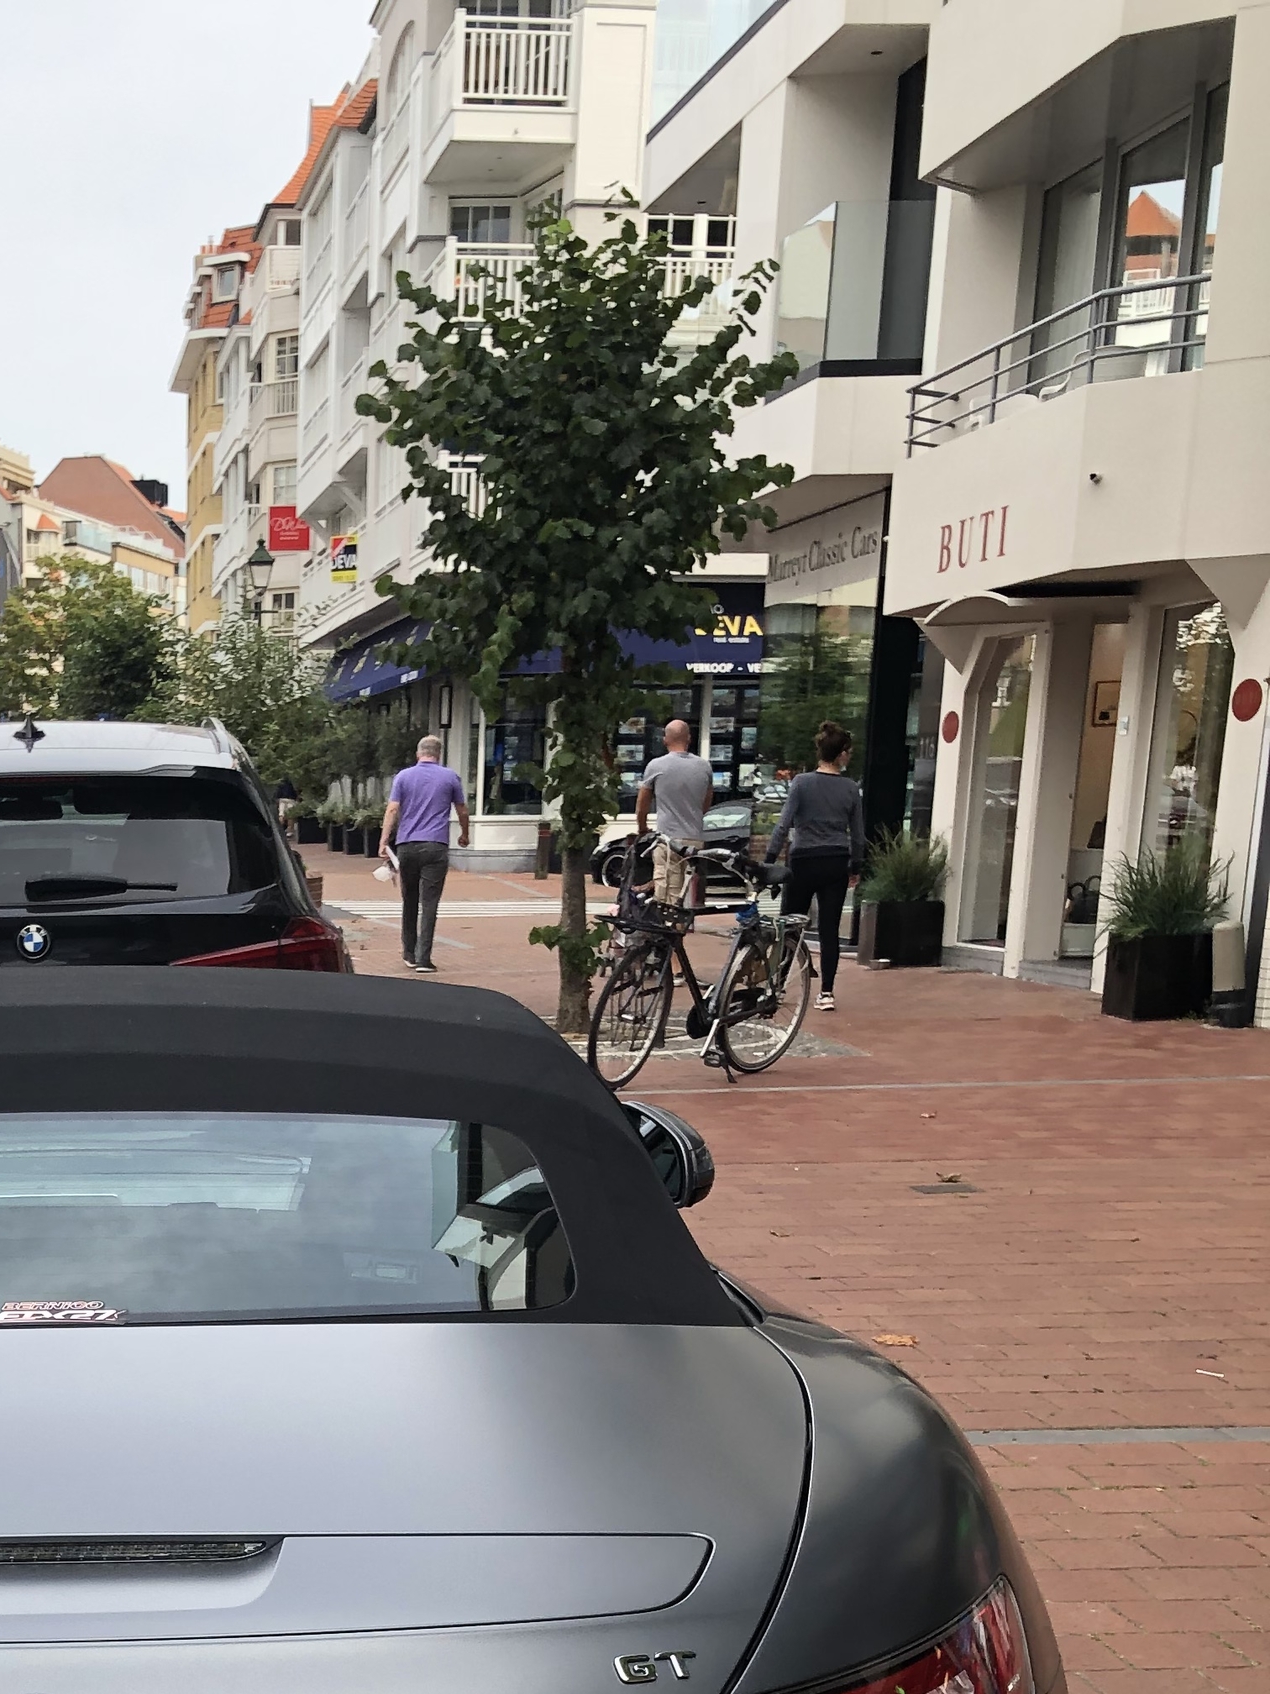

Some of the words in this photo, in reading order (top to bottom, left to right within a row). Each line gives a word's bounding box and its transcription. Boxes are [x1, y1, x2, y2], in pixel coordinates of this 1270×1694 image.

[809, 531, 847, 572] Classic
[851, 526, 878, 559] Cars
[937, 505, 1010, 574] BUTI
[612, 1651, 696, 1685] GT
